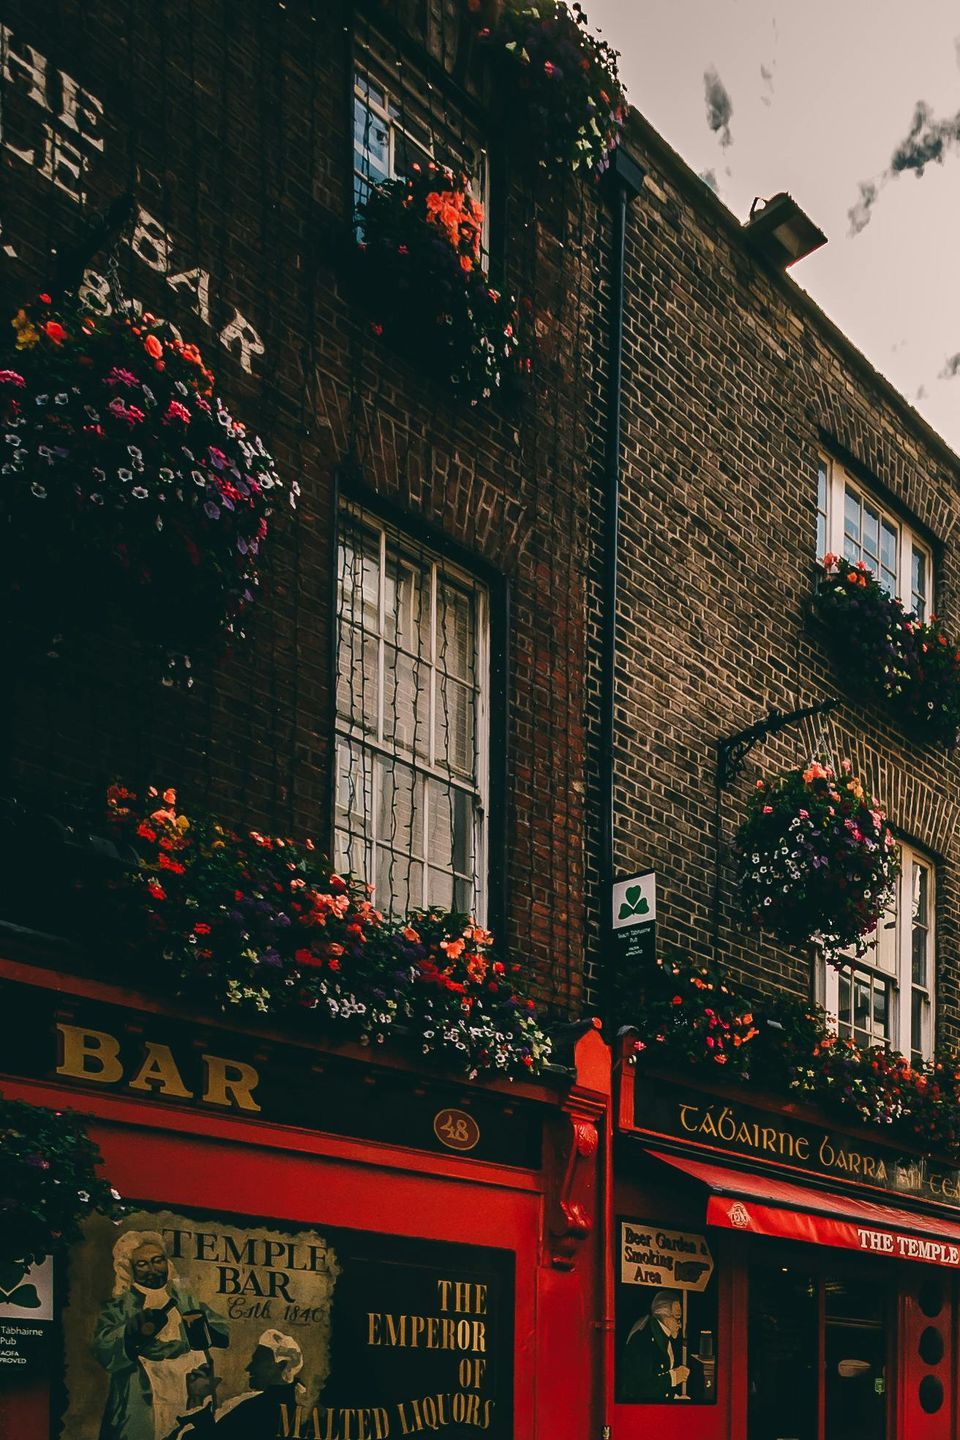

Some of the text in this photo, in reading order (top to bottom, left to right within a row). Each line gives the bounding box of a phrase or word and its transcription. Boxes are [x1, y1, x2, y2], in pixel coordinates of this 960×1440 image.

[55, 1022, 261, 1111] BAR
[440, 1113, 470, 1140] 48
[162, 1229, 329, 1274] TEMPLE
[625, 1227, 652, 1247] Beer
[656, 1232, 697, 1254] Garden
[625, 1246, 674, 1271] Smoking
[858, 1229, 894, 1253] THE
[897, 1236, 960, 1265] TEMPLE
[217, 1265, 296, 1302] BAR
[634, 1266, 663, 1284] Area
[437, 1279, 489, 1316] THE
[0, 1336, 17, 1346] Pub
[366, 1313, 487, 1352] EMPEROR
[458, 1358, 486, 1390] OF
[396, 1392, 496, 1437] LIQUORS
